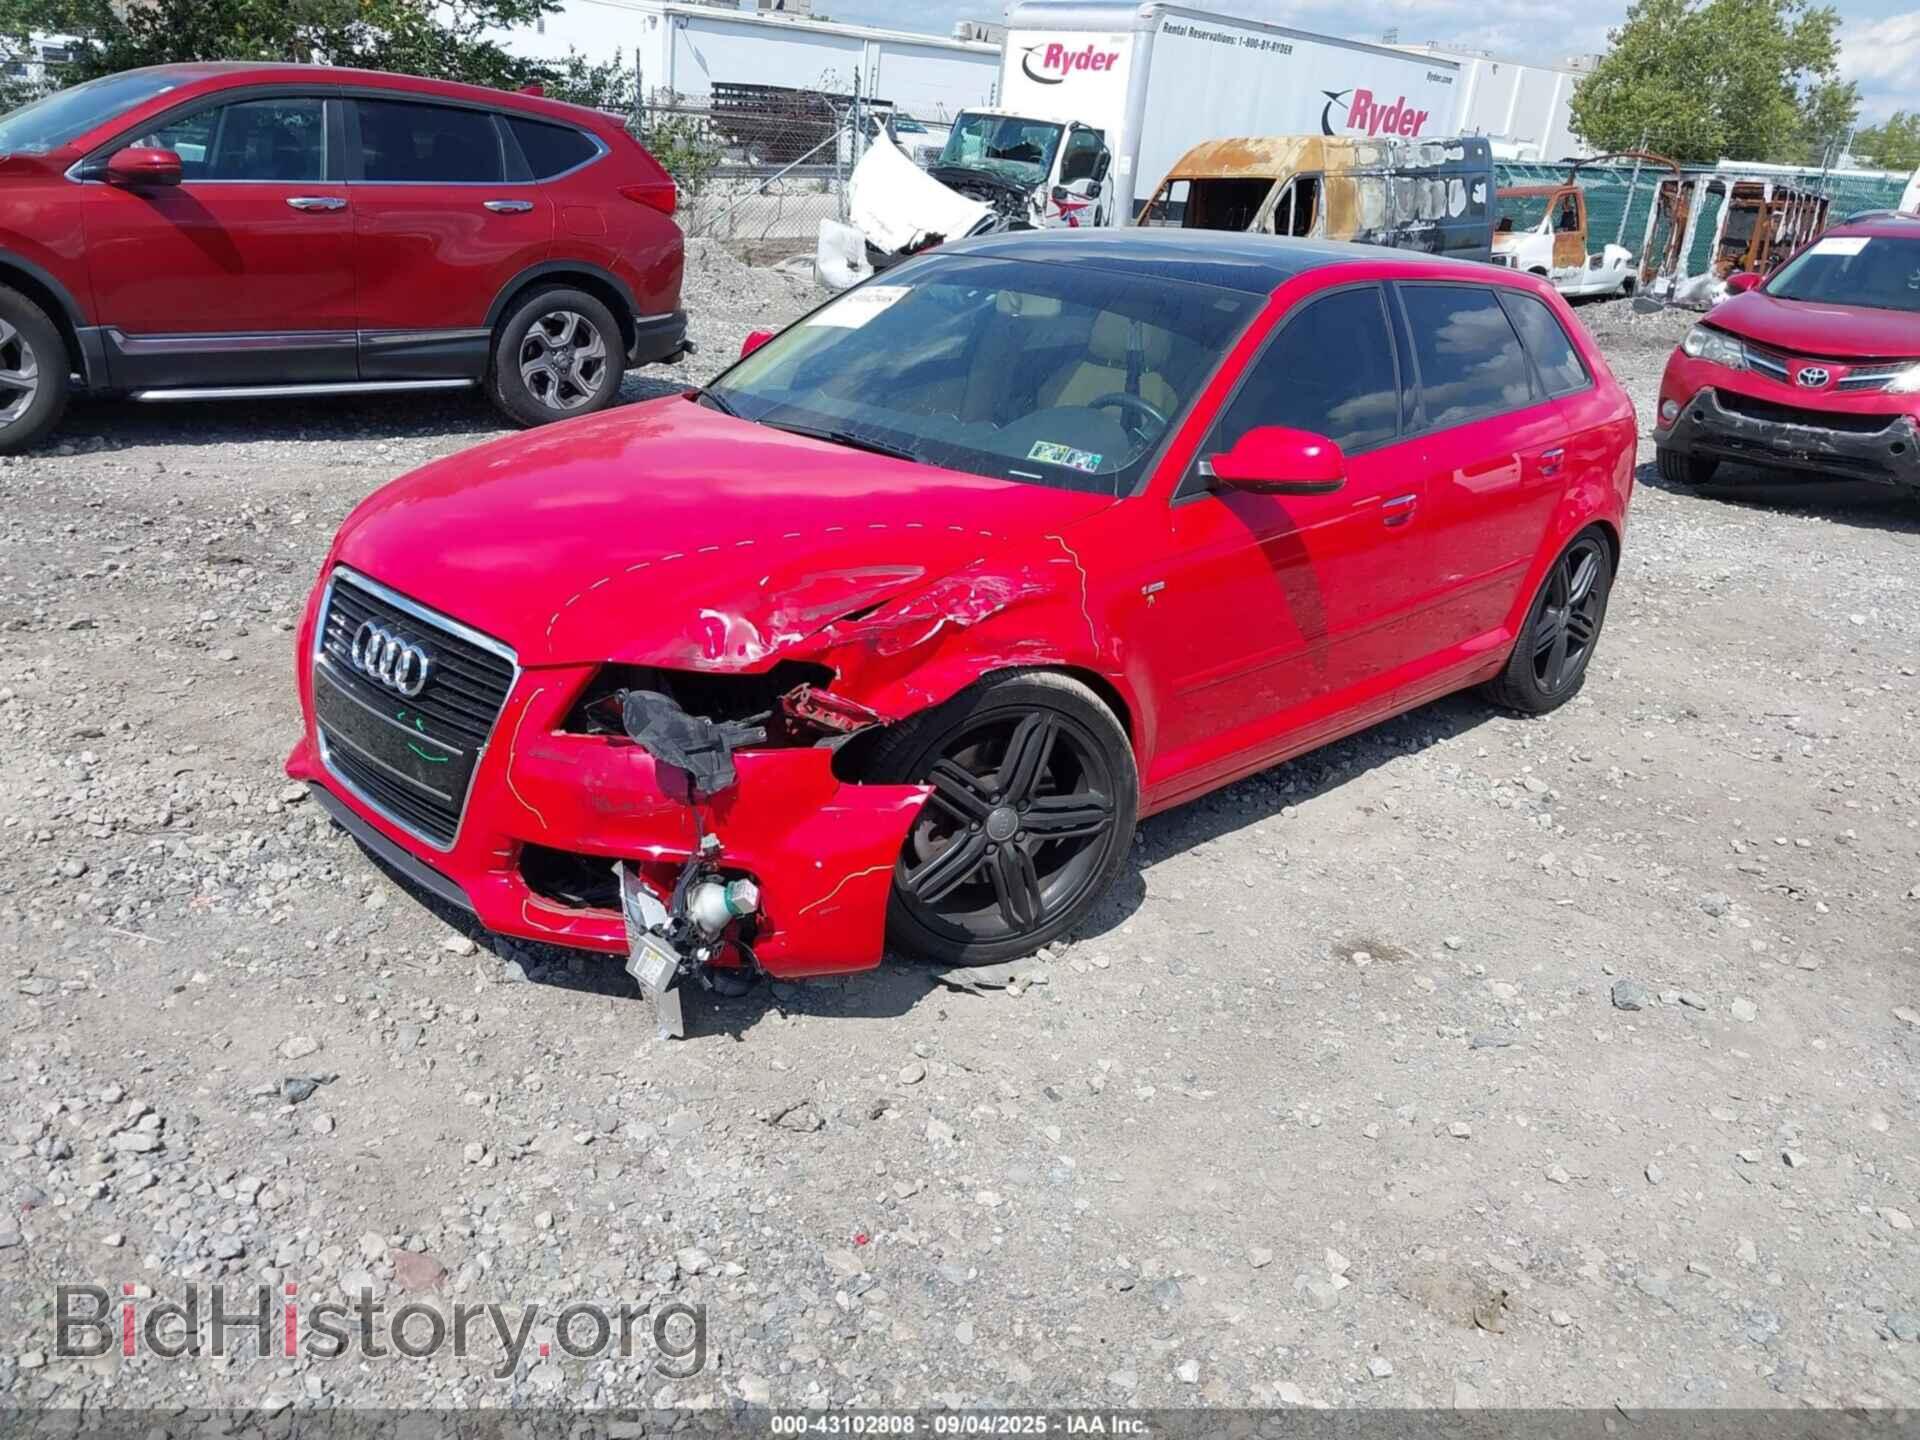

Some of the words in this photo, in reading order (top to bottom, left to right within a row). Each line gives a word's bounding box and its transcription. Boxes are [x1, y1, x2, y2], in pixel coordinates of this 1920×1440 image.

[1163, 21, 1188, 36] Rental
[1188, 26, 1237, 45] Reservations:
[1239, 36, 1293, 56] 1-800-BY-RYDER
[1043, 43, 1119, 75] Ryder
[1346, 88, 1429, 137] Ryder
